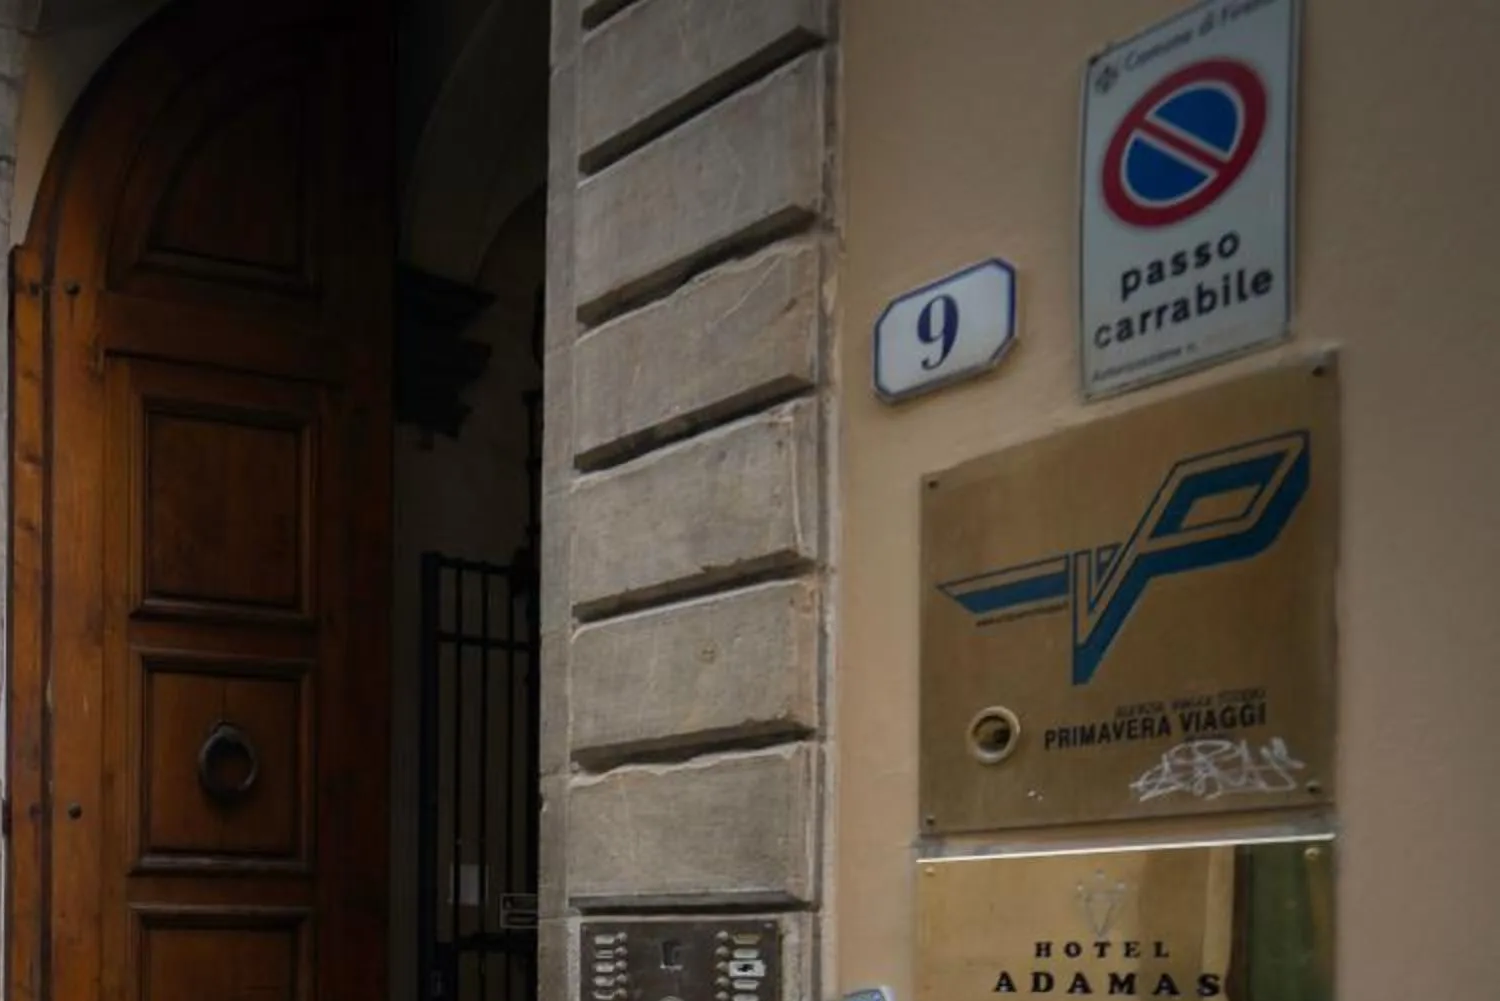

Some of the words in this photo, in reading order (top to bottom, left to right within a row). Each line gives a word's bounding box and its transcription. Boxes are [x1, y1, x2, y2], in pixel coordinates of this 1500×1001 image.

[1120, 230, 1240, 301] passo
[916, 293, 959, 371] 9
[1093, 266, 1273, 350] carrabile
[1044, 713, 1171, 750] PRIMAVERA
[1179, 703, 1267, 733] VIAGGI
[1035, 941, 1170, 959] HOTEL
[992, 970, 1222, 997] ADAMAS
